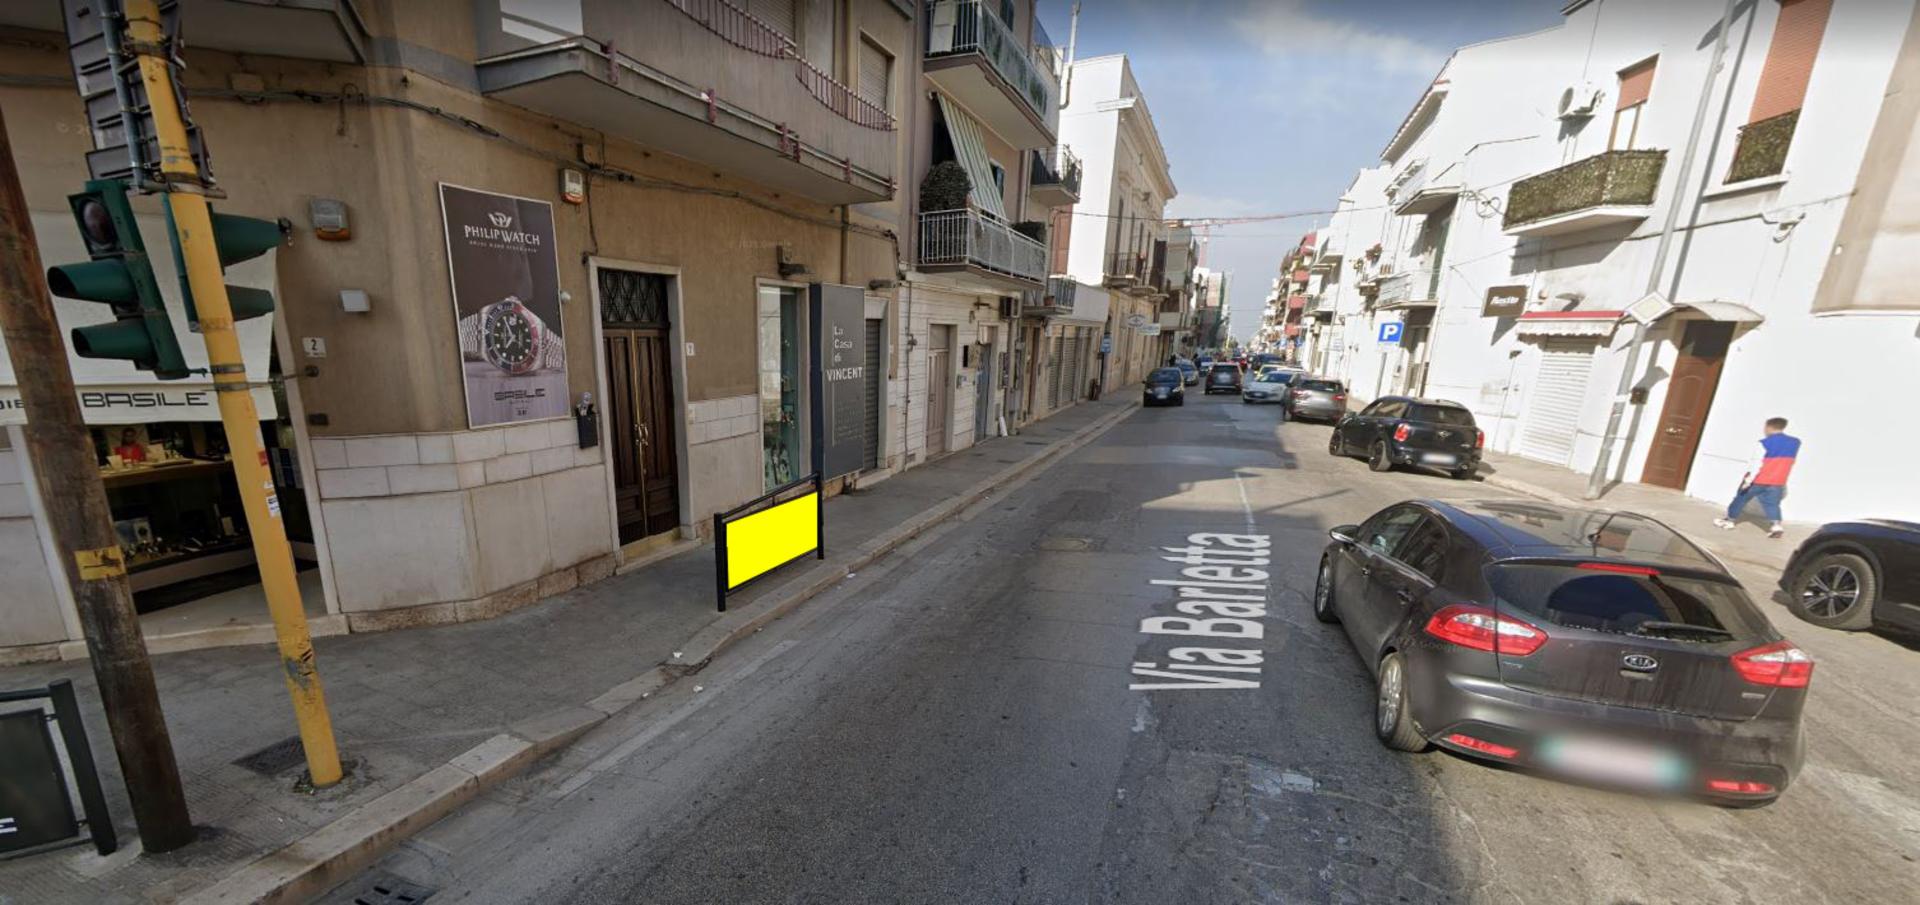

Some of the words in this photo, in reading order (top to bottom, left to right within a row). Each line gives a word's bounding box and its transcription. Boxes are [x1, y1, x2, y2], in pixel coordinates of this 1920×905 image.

[464, 225, 500, 239] PHILIP
[501, 231, 540, 246] WATCH
[1382, 325, 1398, 340] P
[310, 339, 317, 351] 2
[827, 367, 863, 381] VINCENT
[82, 392, 209, 408] BASILE
